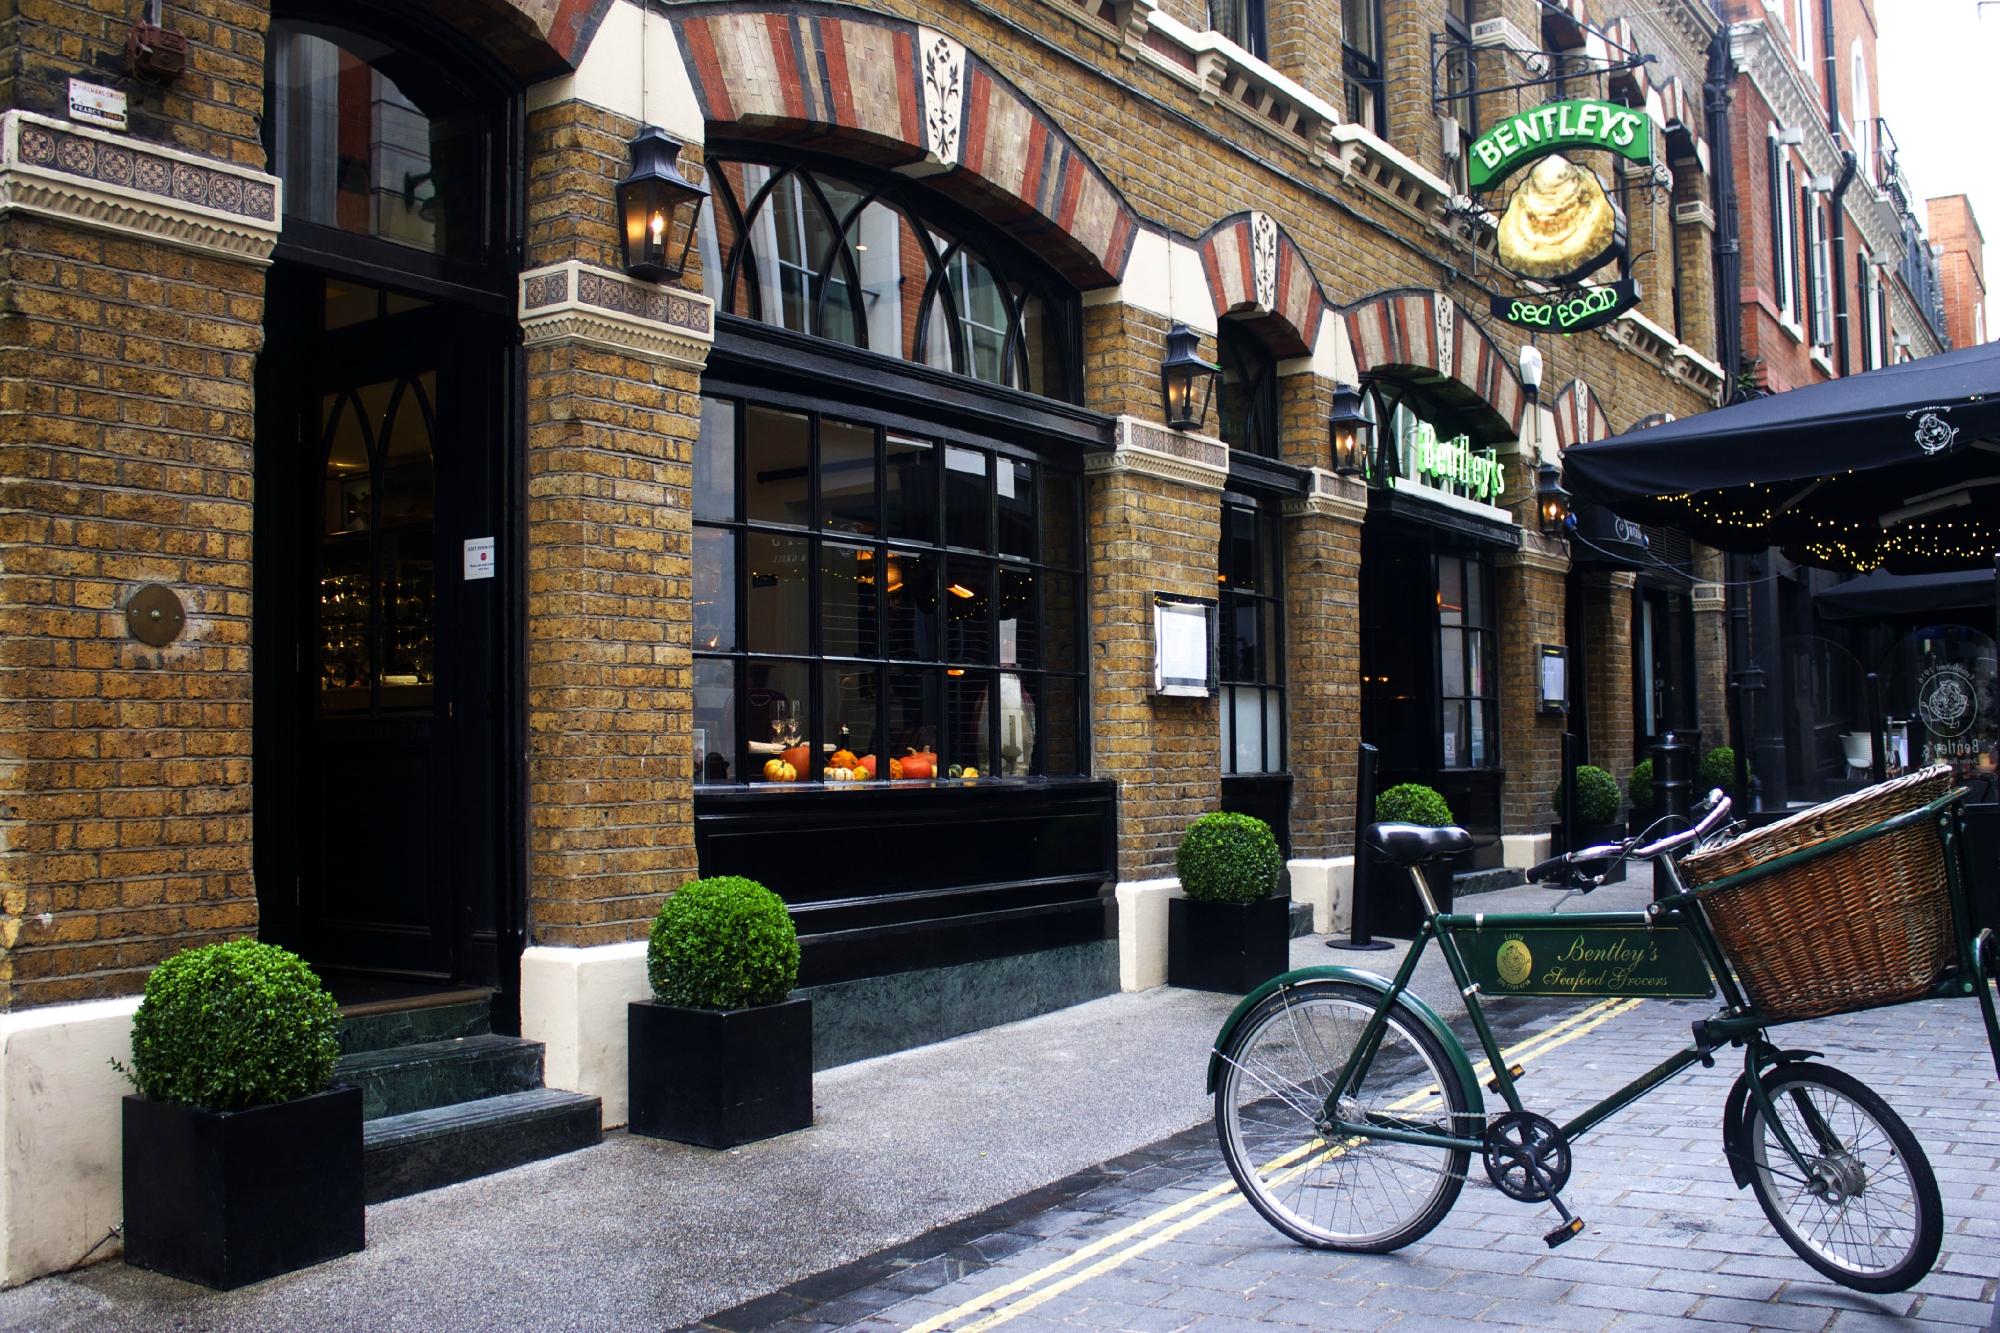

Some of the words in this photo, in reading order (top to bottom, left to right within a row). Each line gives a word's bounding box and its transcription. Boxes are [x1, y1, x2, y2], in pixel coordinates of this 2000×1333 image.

[1475, 104, 1642, 169] BENTLEYS
[1557, 935, 1659, 972] Bentley's
[1542, 966, 1604, 992] Seafood
[1607, 966, 1668, 990] Grocers
